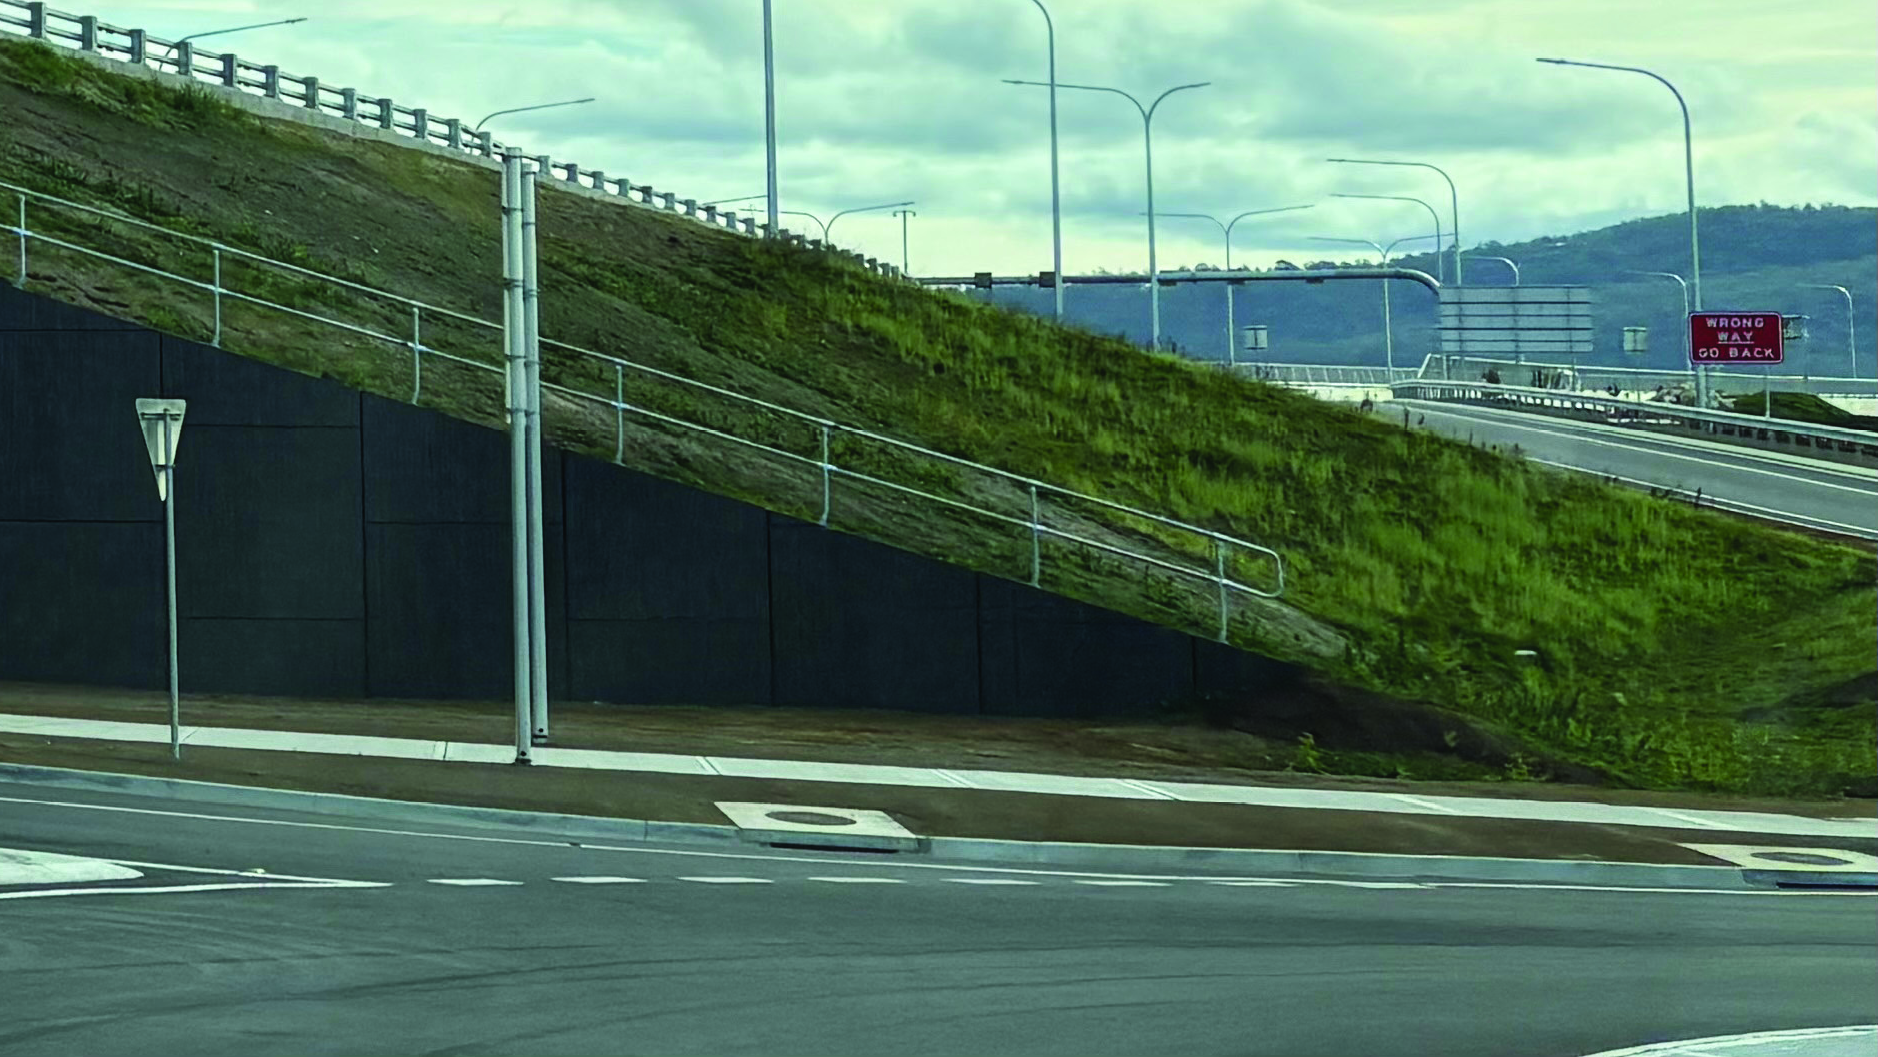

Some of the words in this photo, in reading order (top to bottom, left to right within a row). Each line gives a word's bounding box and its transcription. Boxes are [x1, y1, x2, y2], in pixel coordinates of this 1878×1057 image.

[1705, 317, 1764, 328] WRONG
[1717, 331, 1753, 341] WAY
[1698, 347, 1719, 358] GO
[1728, 347, 1775, 358] BACK
